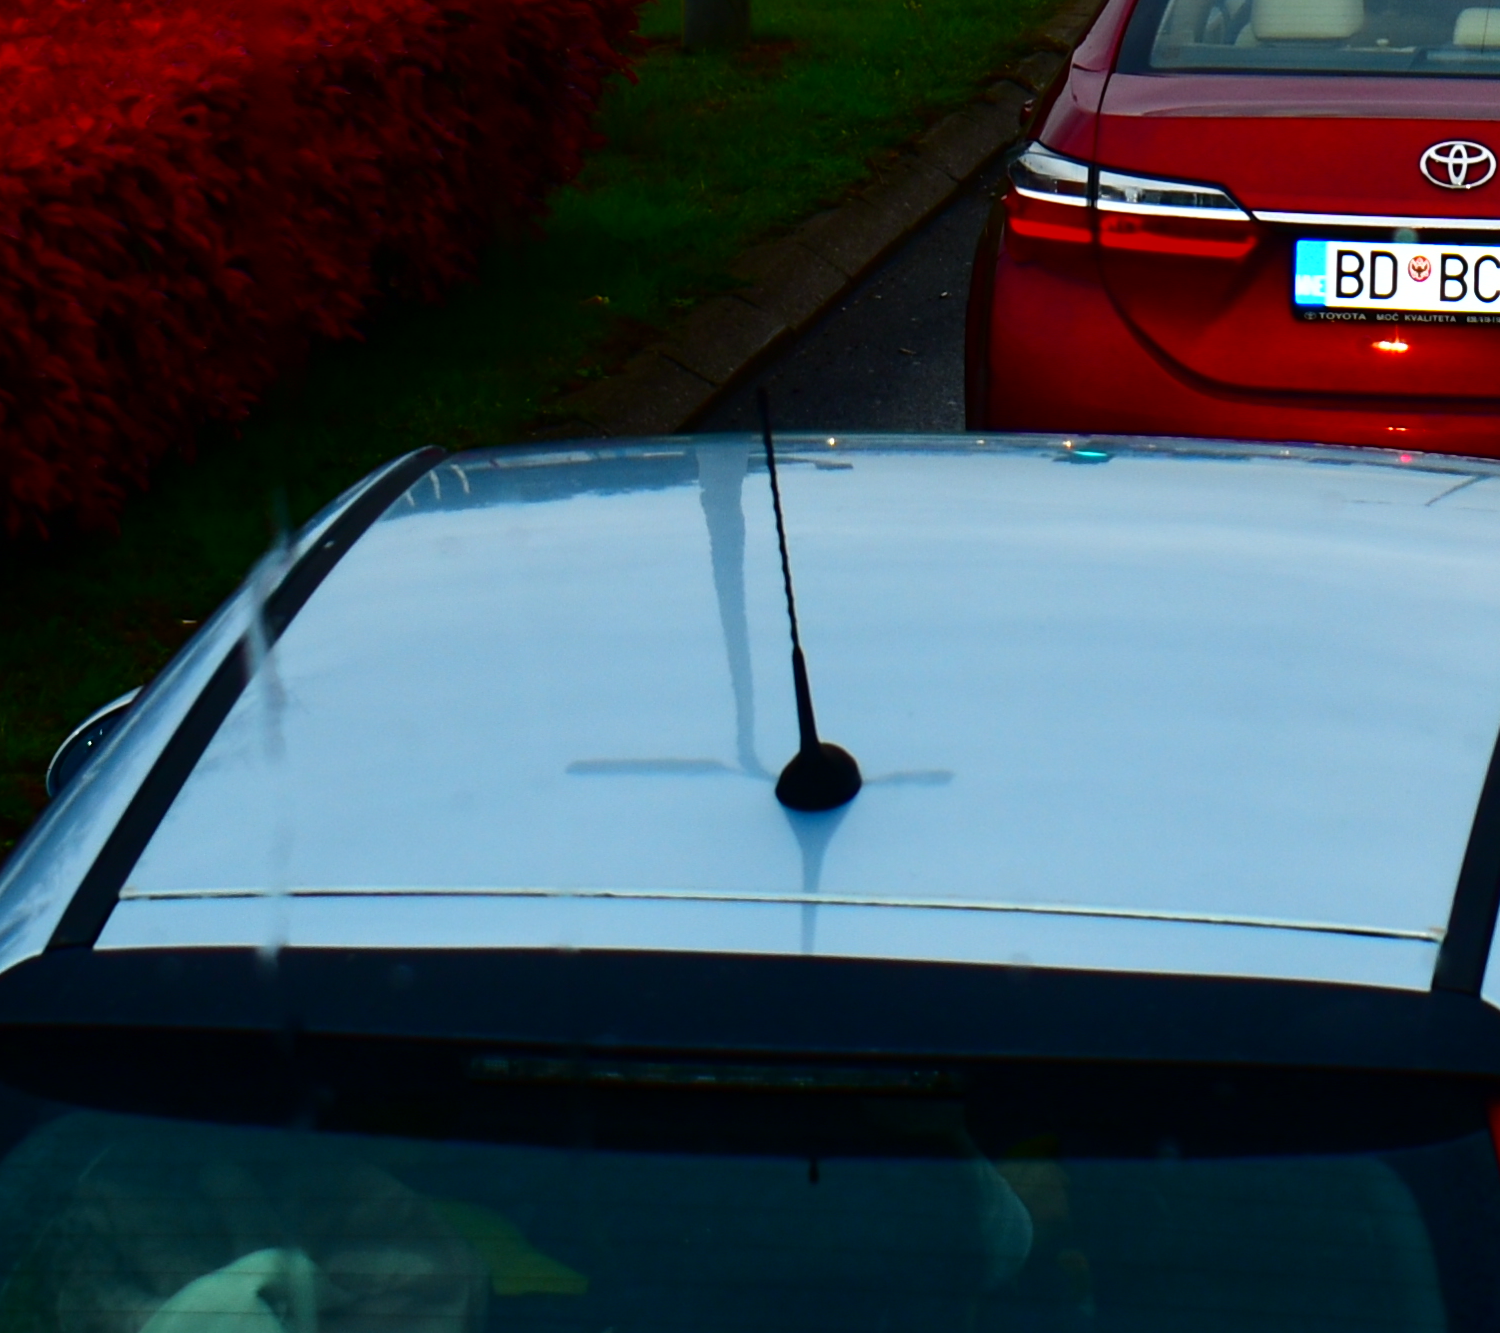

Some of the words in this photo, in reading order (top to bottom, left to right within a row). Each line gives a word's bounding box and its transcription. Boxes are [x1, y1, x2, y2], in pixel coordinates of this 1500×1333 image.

[1336, 249, 1398, 300] BD
[1319, 311, 1367, 321] TOYOTA
[1404, 313, 1457, 323] KVALITETA
